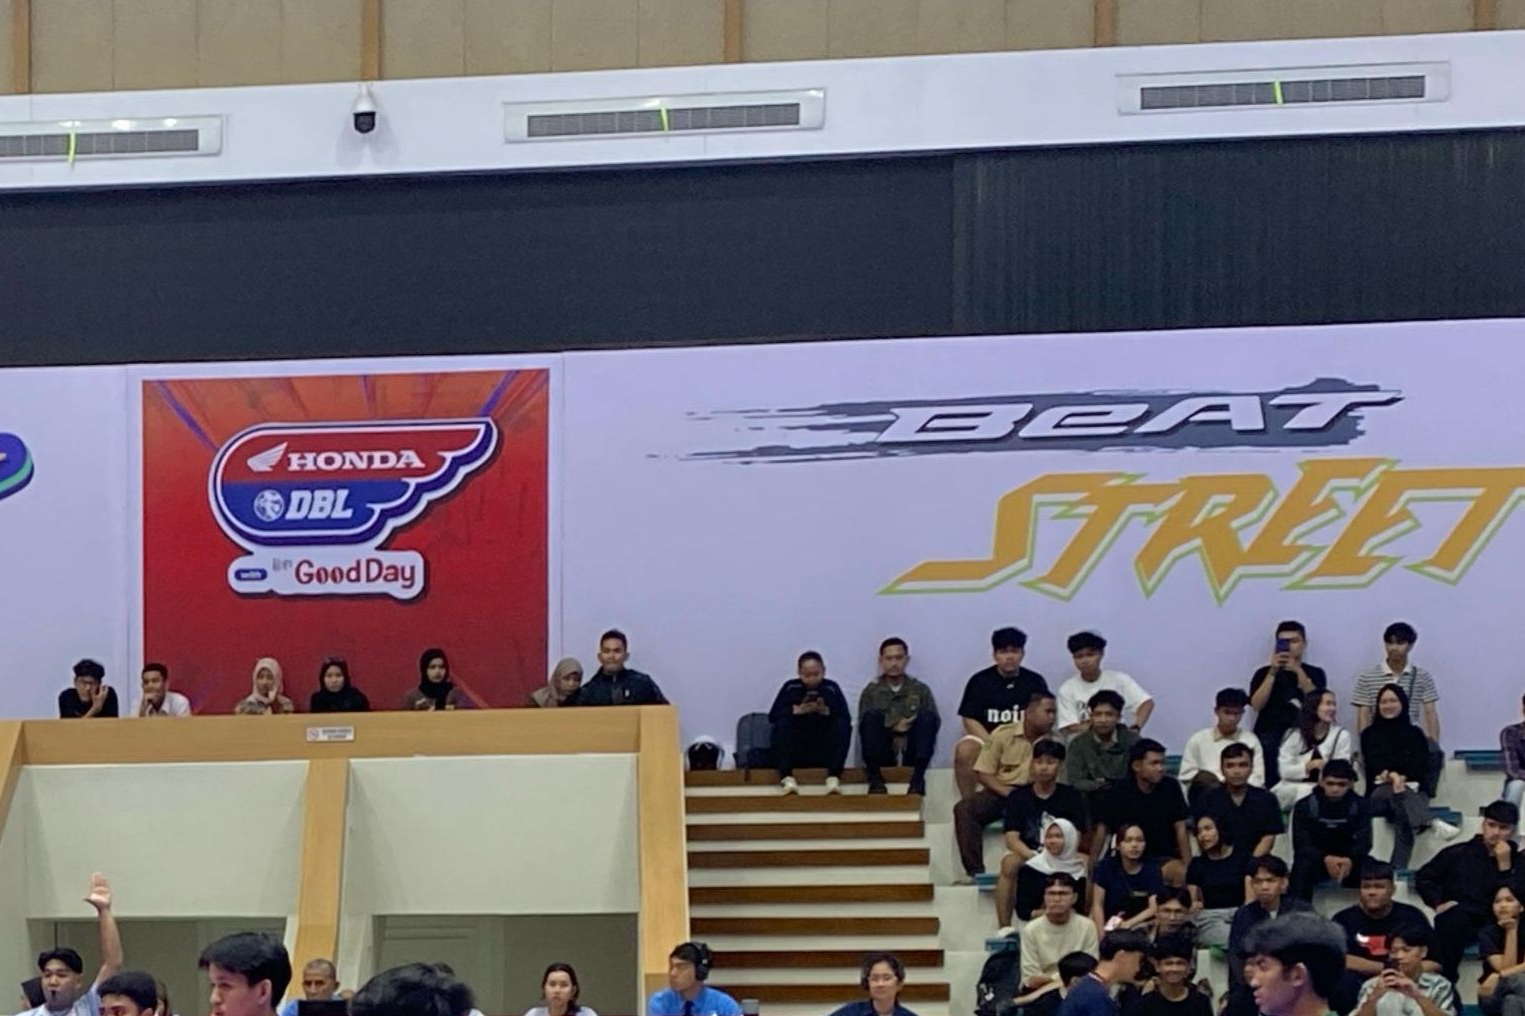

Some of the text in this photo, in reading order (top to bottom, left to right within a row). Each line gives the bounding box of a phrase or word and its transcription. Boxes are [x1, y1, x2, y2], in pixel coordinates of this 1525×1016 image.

[287, 450, 425, 471] HONDA
[284, 488, 354, 520] DBL
[878, 456, 1525, 606] STREET
[294, 559, 361, 584] Good
[365, 557, 416, 589] Day
